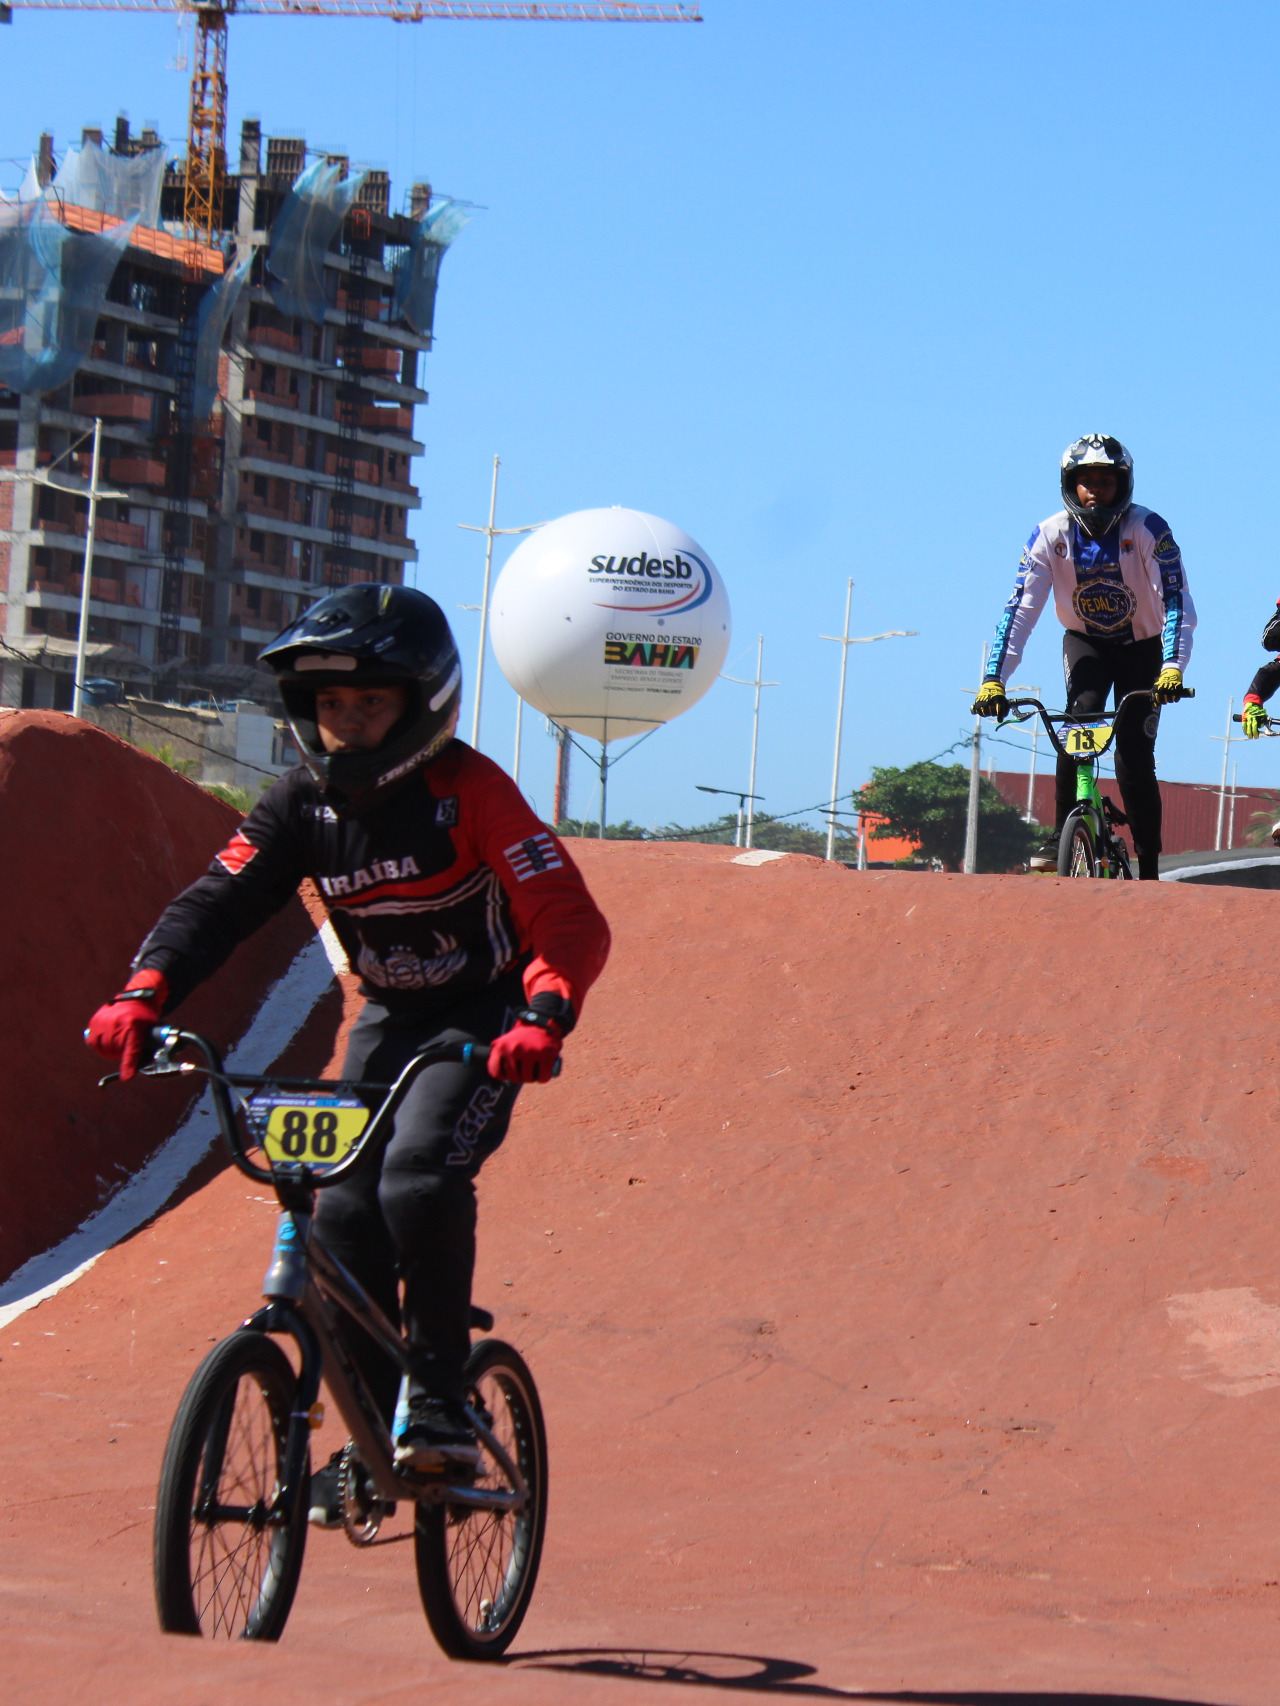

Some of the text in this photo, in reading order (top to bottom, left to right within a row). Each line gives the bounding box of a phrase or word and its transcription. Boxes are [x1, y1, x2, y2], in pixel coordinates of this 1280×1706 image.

[587, 552, 692, 580] sudesb
[1080, 596, 1114, 613] PEDAL
[606, 632, 702, 646] GOVERNO DO ESTADO
[604, 641, 695, 669] BAHIA
[1072, 729, 1096, 751] 13
[281, 1110, 339, 1159] 88
